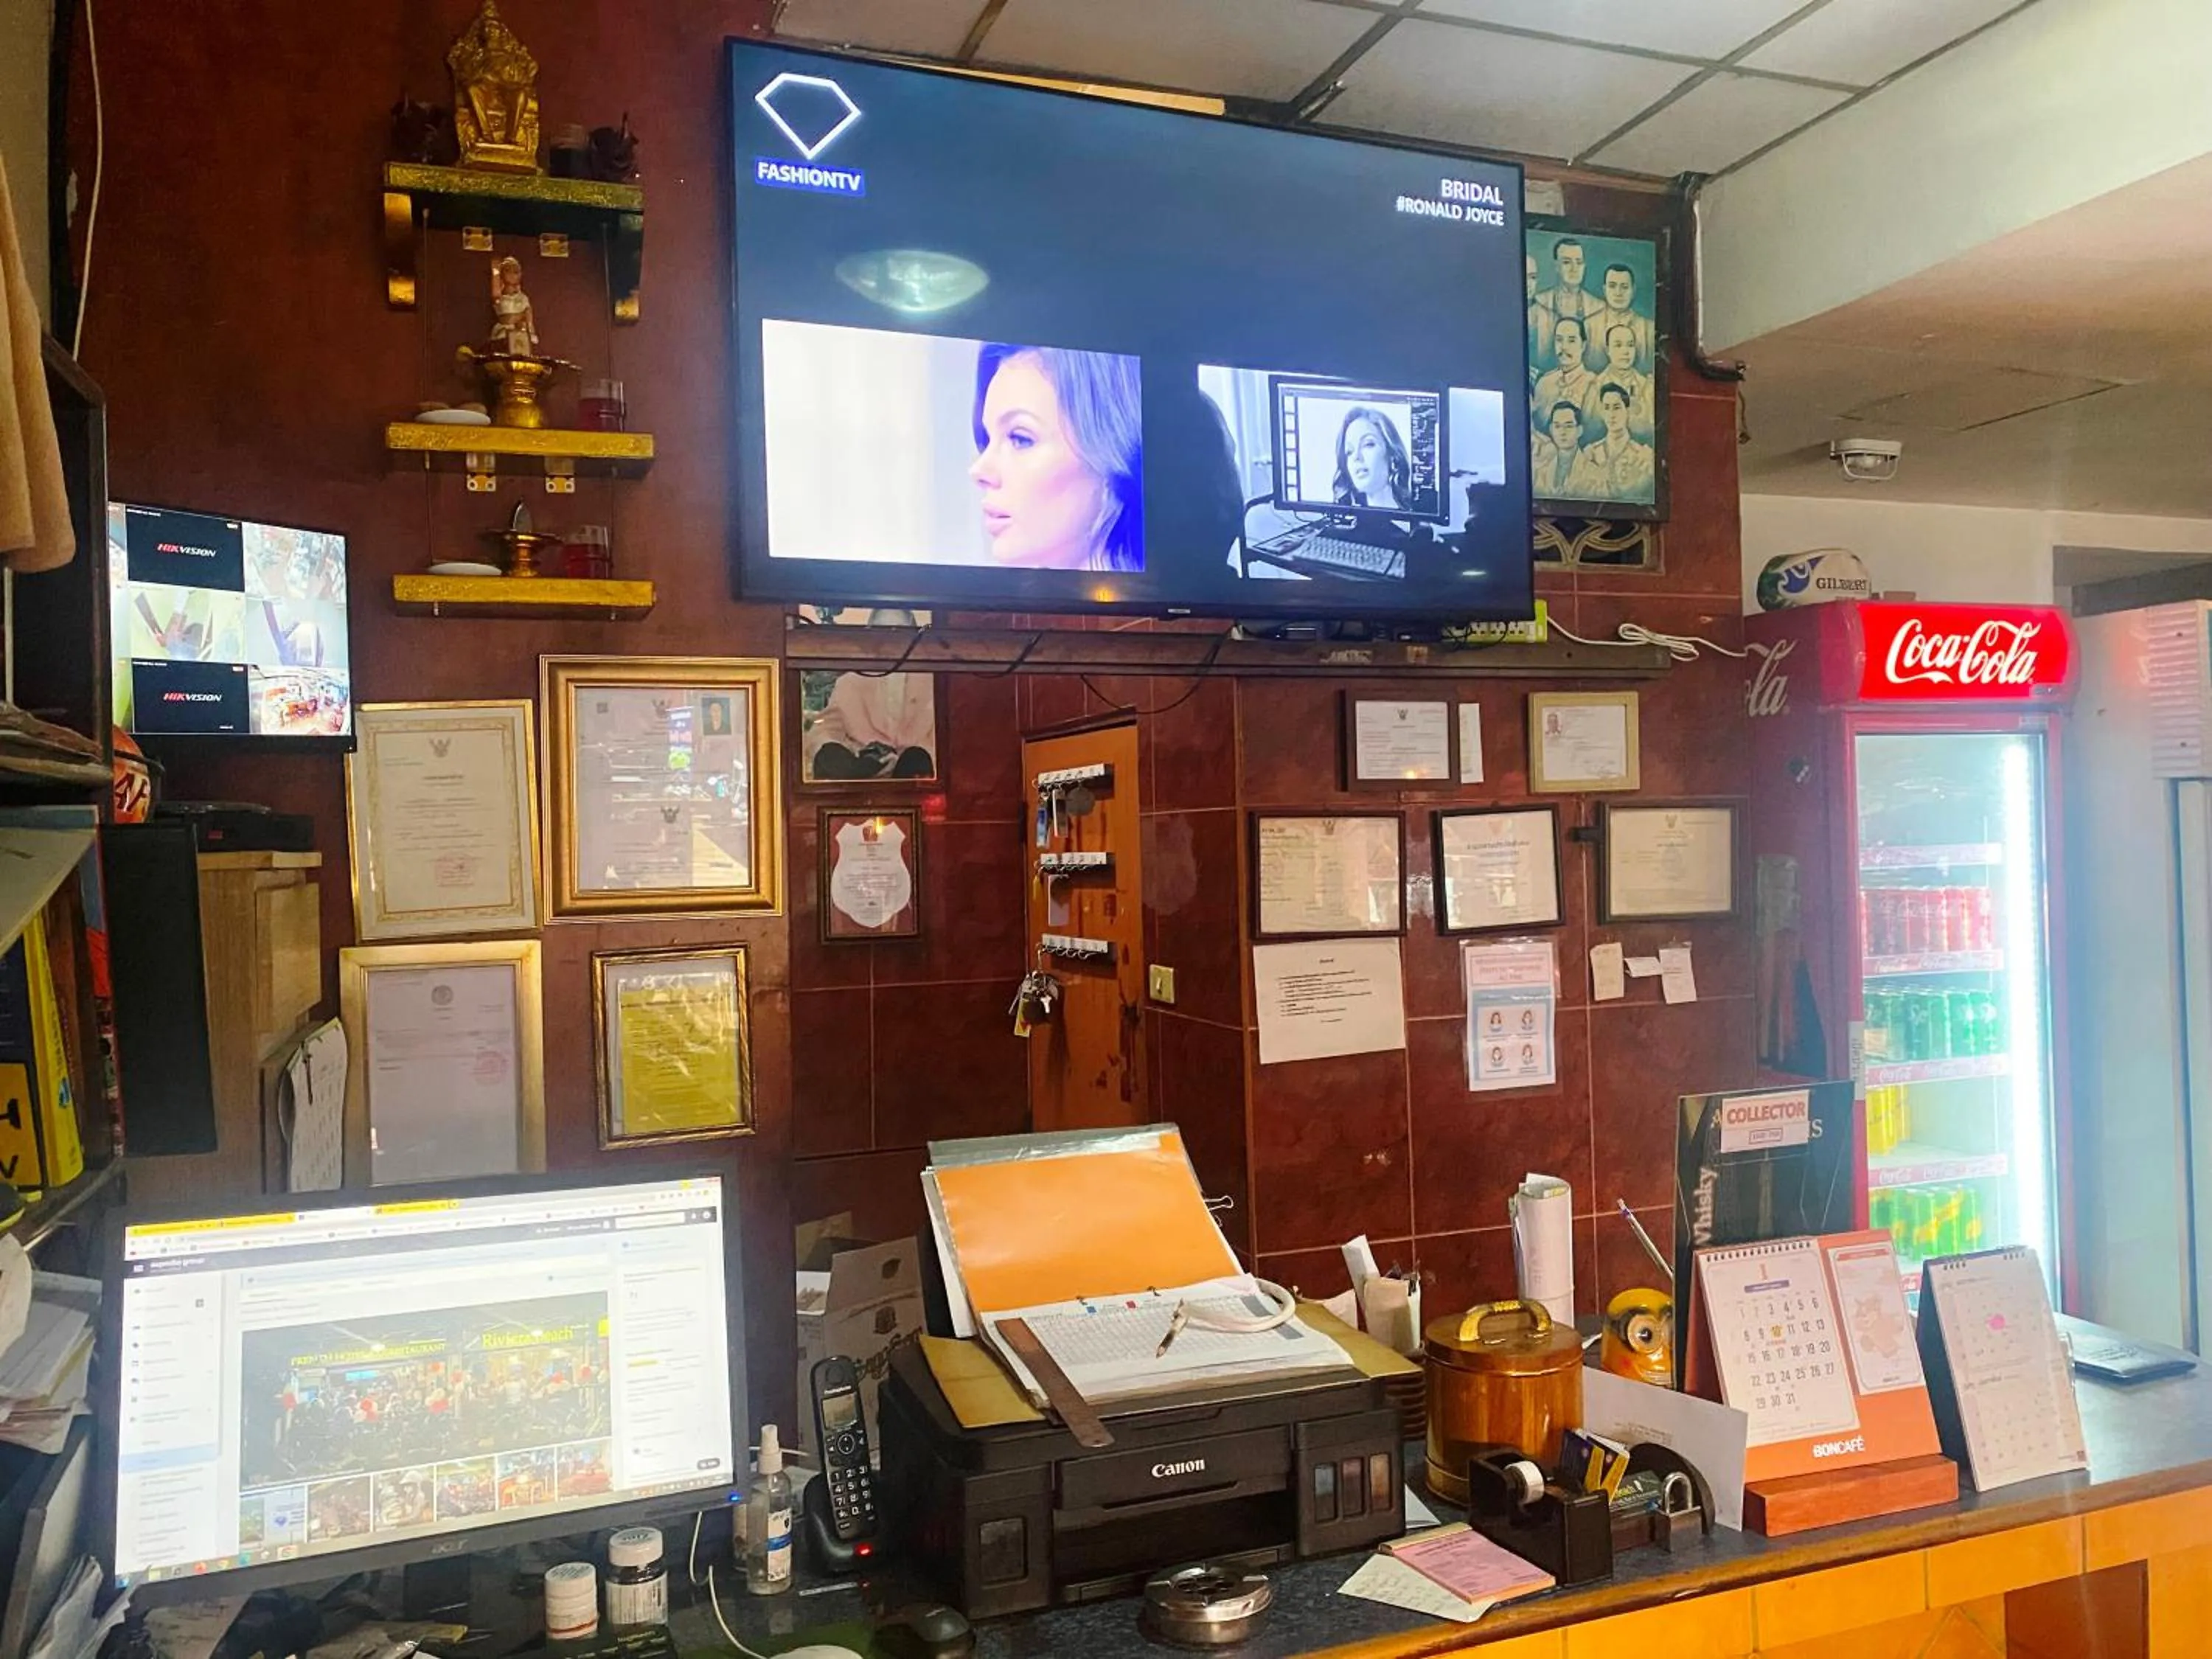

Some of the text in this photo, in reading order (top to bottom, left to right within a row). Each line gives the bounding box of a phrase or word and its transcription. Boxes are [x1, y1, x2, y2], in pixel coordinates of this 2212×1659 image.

[757, 161, 860, 191] FASHIONTV
[1441, 178, 1503, 206] BRIDAL
[1396, 195, 1504, 226] #RONALD JOYCE
[156, 542, 216, 558] HIKVISION
[1885, 618, 2042, 685] Coca-Cola
[162, 692, 222, 703] HIKVISION
[1726, 1101, 1806, 1124] COLLECTOR
[1812, 1434, 1865, 1458] BONCAFÉ
[1151, 1459, 1206, 1478] Canon
